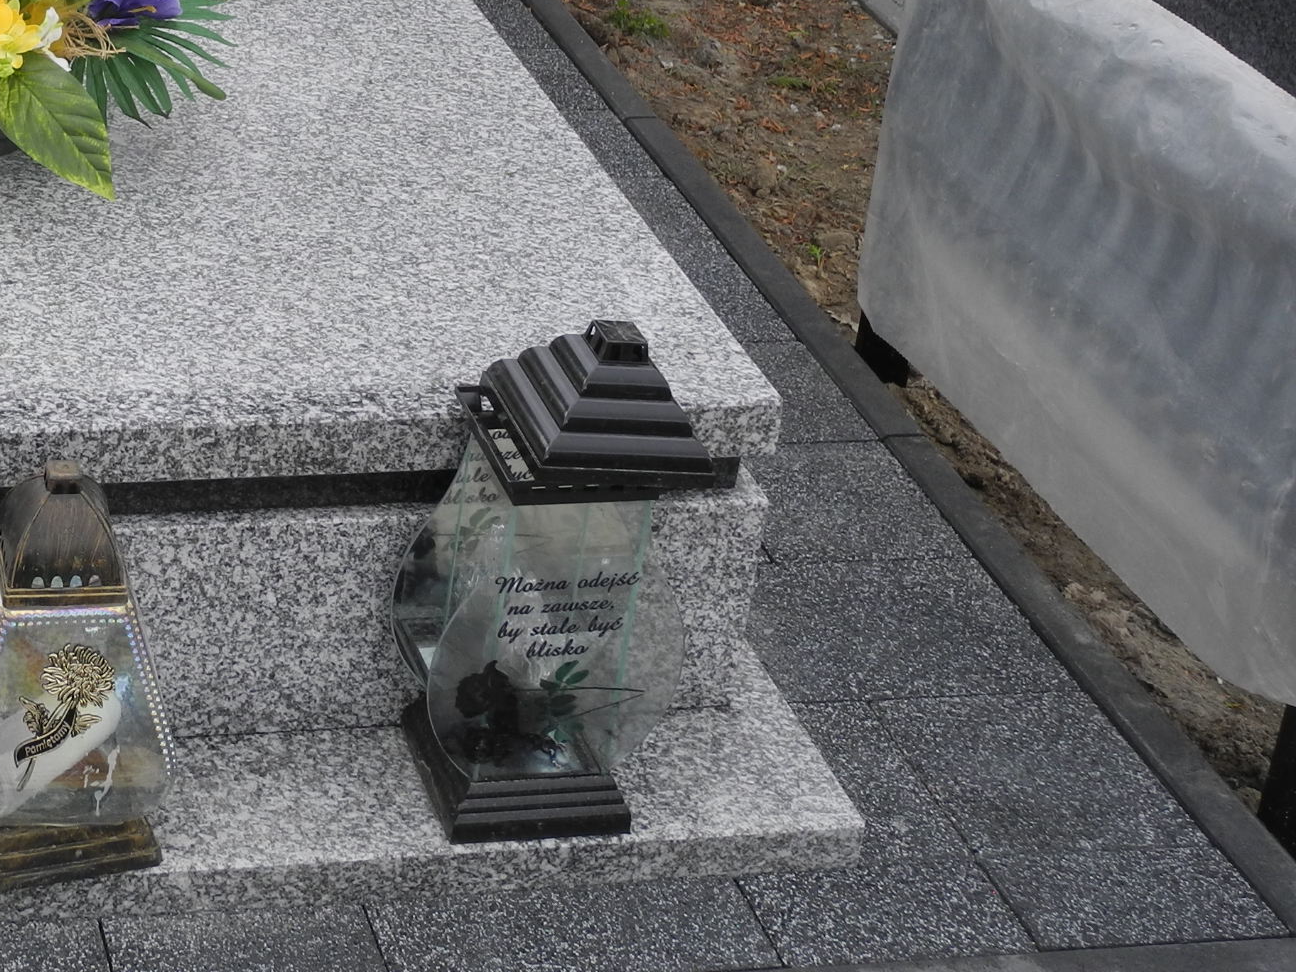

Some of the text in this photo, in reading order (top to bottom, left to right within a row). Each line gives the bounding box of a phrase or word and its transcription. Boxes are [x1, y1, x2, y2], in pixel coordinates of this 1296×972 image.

[494, 571, 640, 594] Można odejść
[507, 604, 534, 616] na
[497, 616, 625, 644] by stale być
[526, 639, 590, 659] blisko
[24, 720, 71, 757] Pamiętamy
